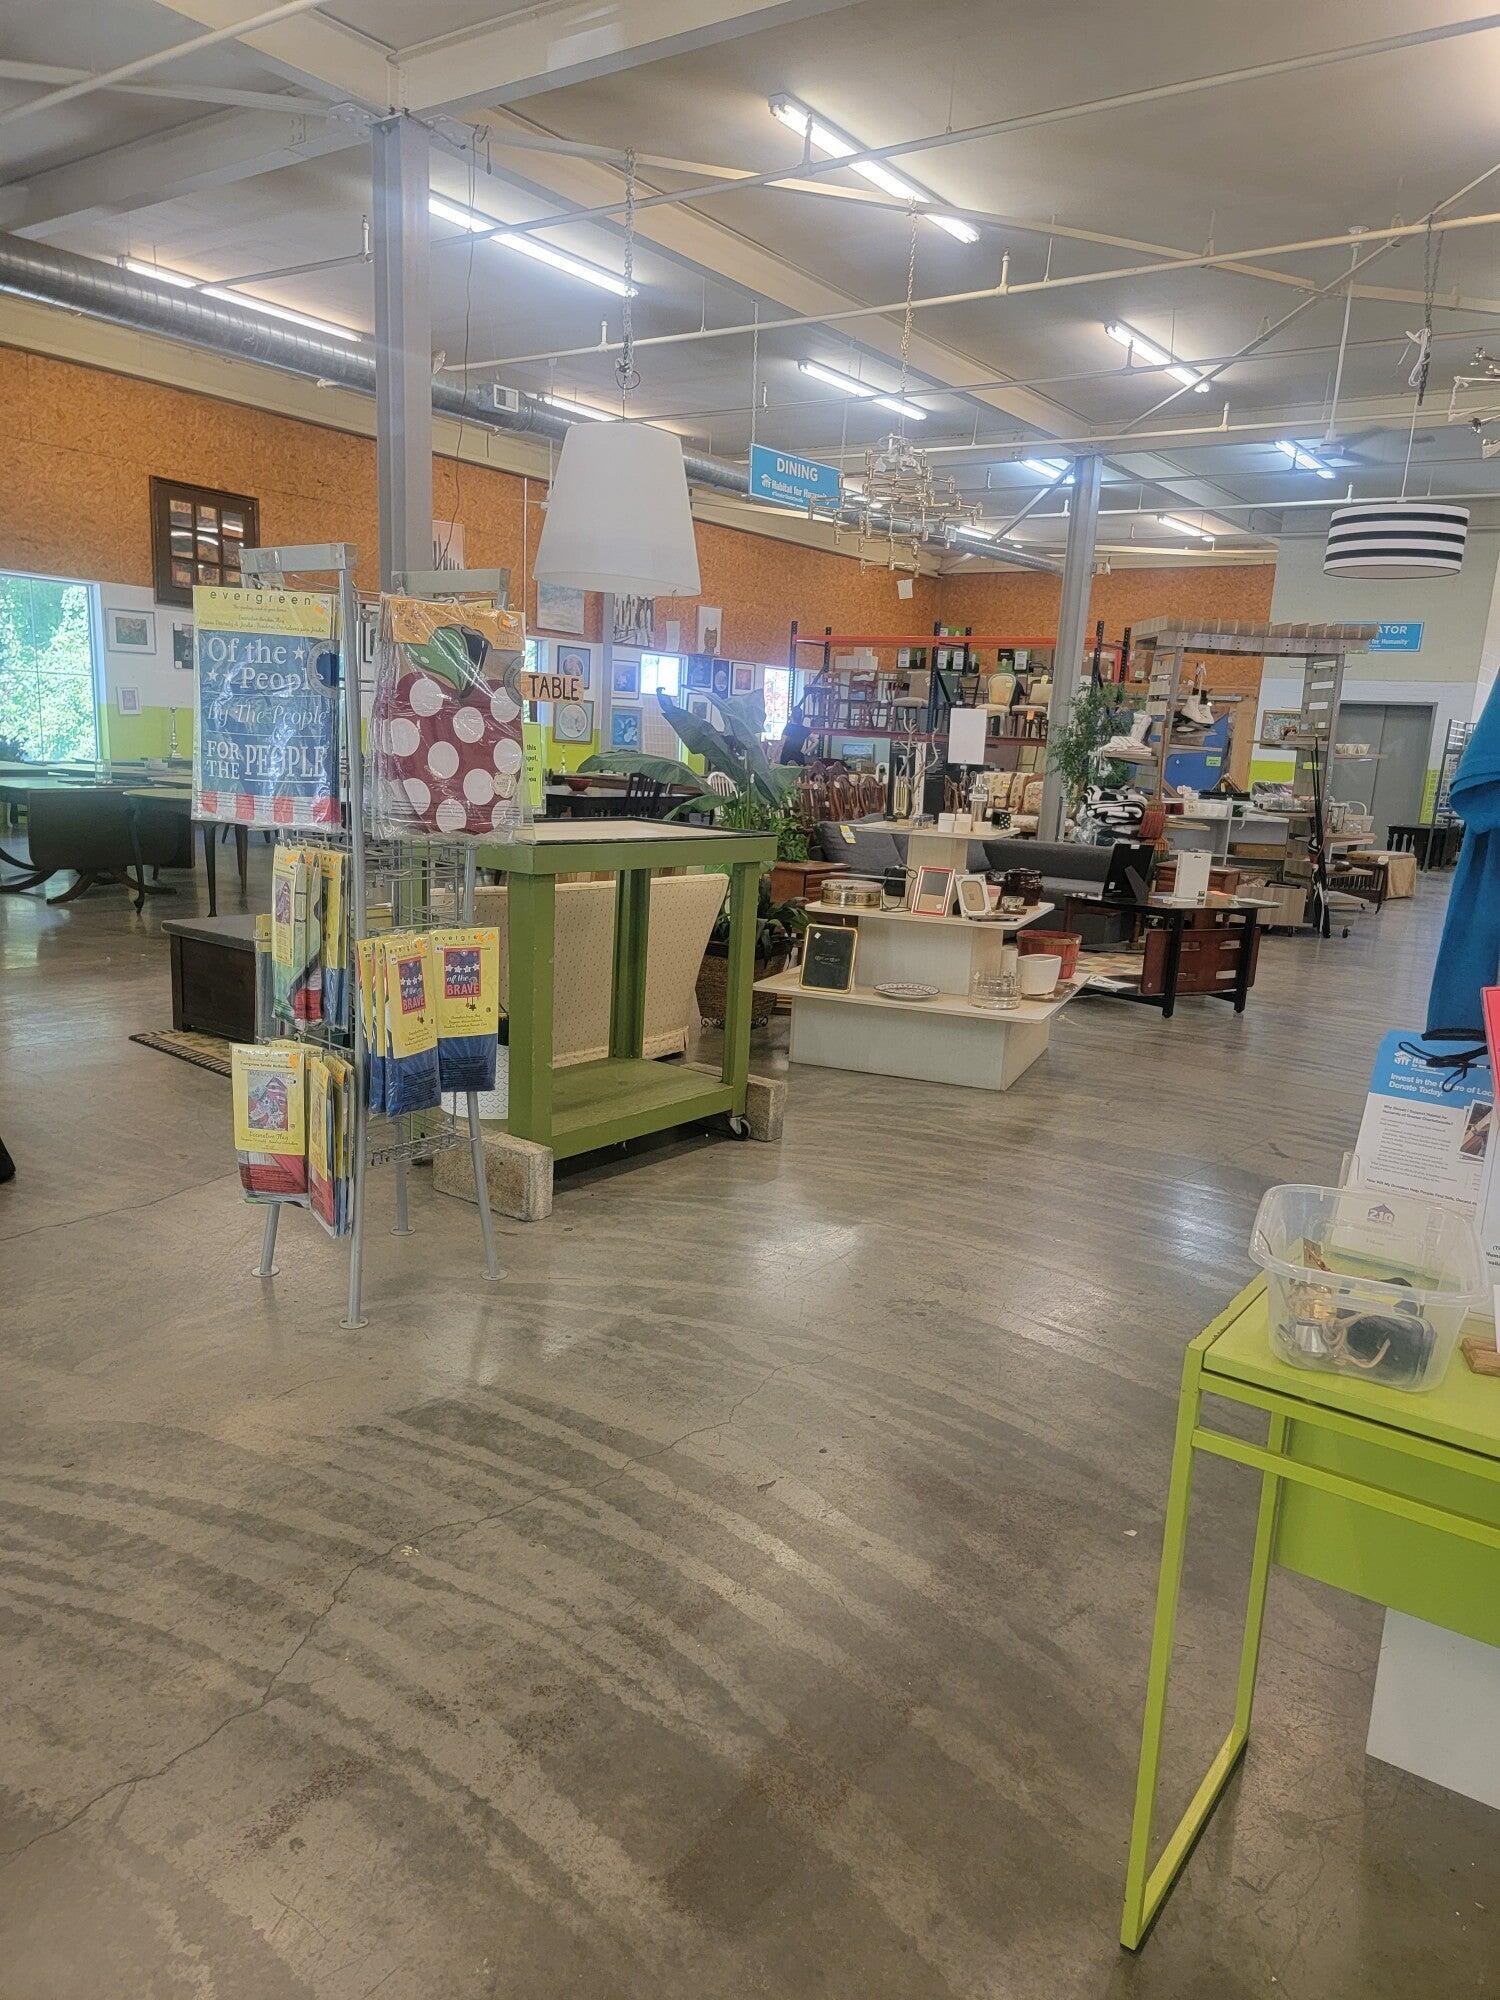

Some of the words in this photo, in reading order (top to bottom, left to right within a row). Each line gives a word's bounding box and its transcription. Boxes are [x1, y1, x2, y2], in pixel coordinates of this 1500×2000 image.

[776, 458, 818, 481] DINING
[771, 480, 793, 494] Habitat
[794, 485, 803, 496] for
[209, 590, 311, 606] evergreen
[1378, 625, 1408, 634] ATOR
[207, 638, 240, 663] Of
[244, 638, 288, 665] the
[528, 674, 580, 701] TABLE
[236, 705, 266, 723] The
[271, 705, 328, 730] People
[206, 740, 240, 760] FOR
[244, 744, 328, 777] PEOPLE
[206, 760, 240, 780] THE
[447, 984, 479, 996] BRAVE
[402, 997, 425, 1011] BRAVE
[1388, 1081, 1417, 1092] Donate
[1420, 1086, 1443, 1098] Today.
[1390, 1073, 1414, 1083] Invest
[1416, 1076, 1422, 1084] in
[1424, 1077, 1438, 1087] the
[1466, 1086, 1476, 1094] of
